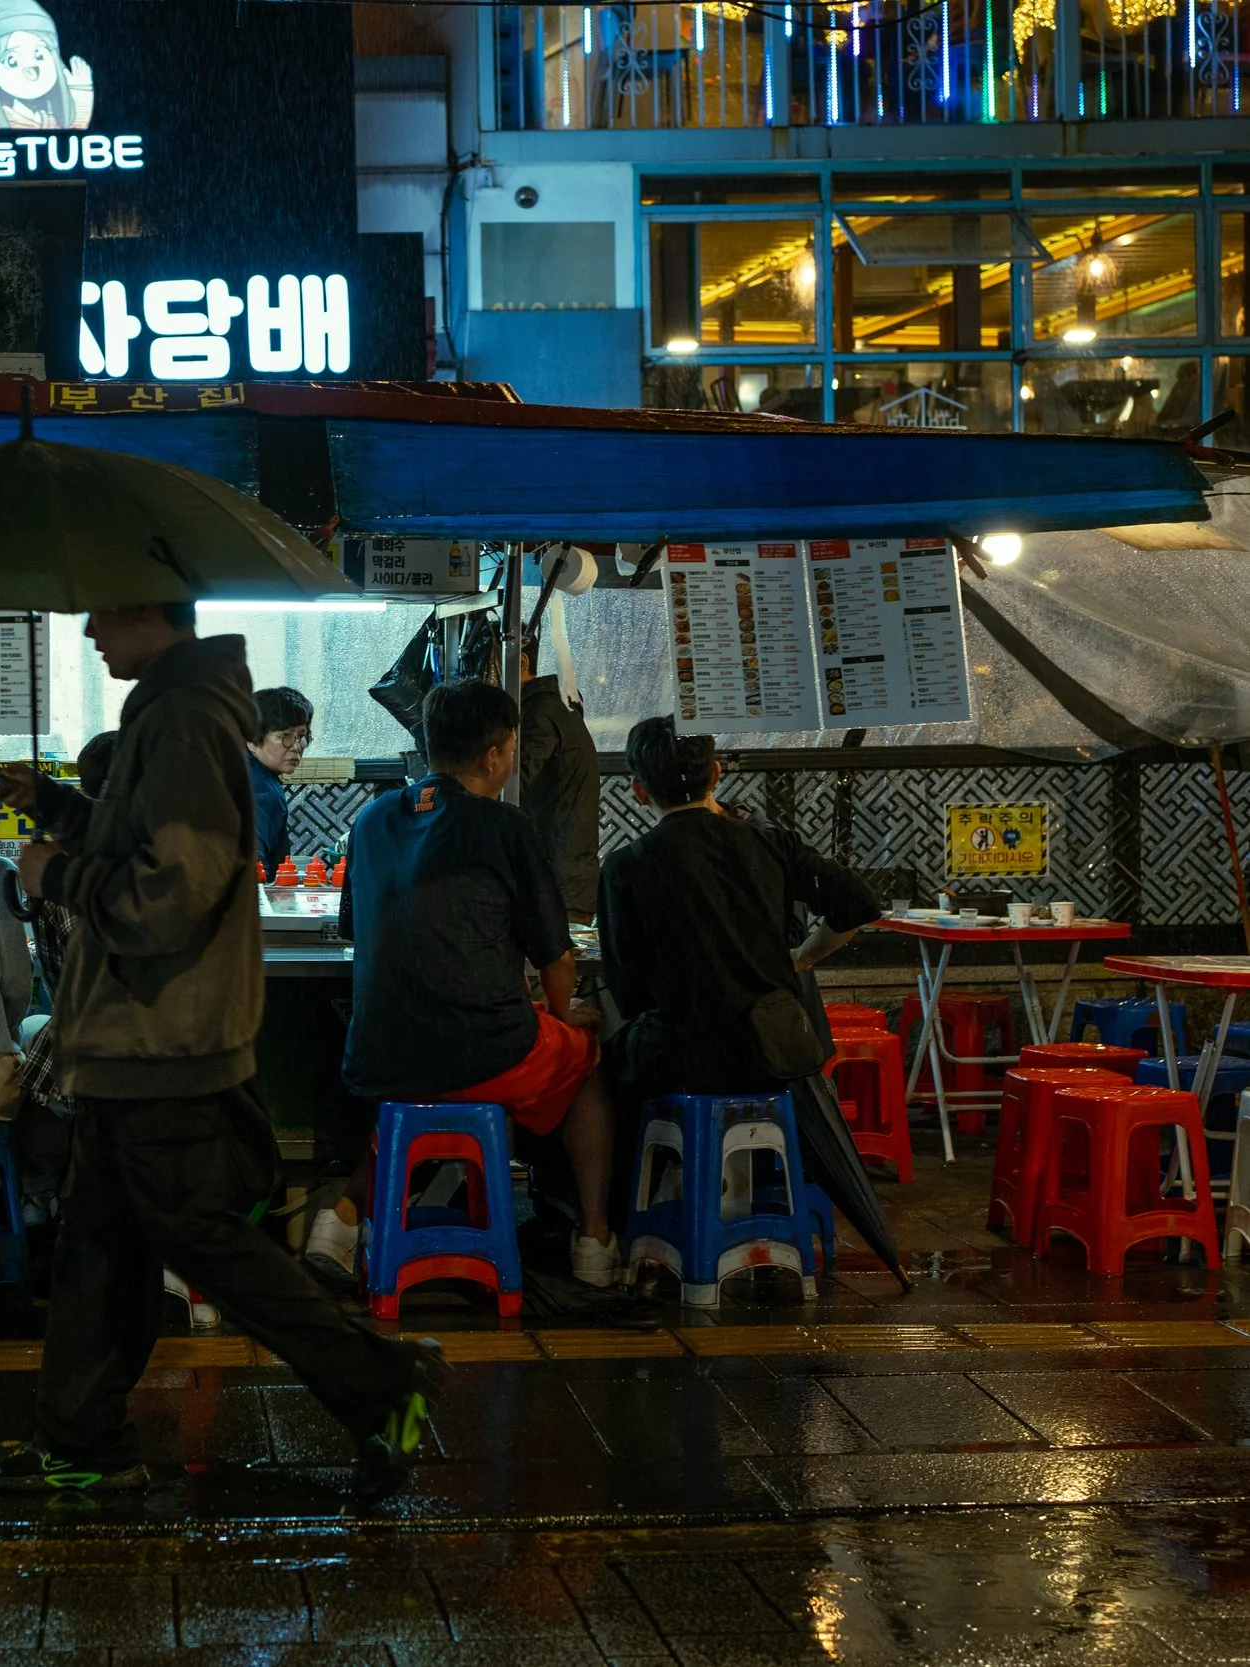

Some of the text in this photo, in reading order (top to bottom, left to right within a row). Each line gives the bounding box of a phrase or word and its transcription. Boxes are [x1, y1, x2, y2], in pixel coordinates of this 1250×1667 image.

[372, 555, 405, 569] 막걸리
[958, 811, 1033, 826] 추락주의
[959, 851, 1035, 865] 기대지마시오
